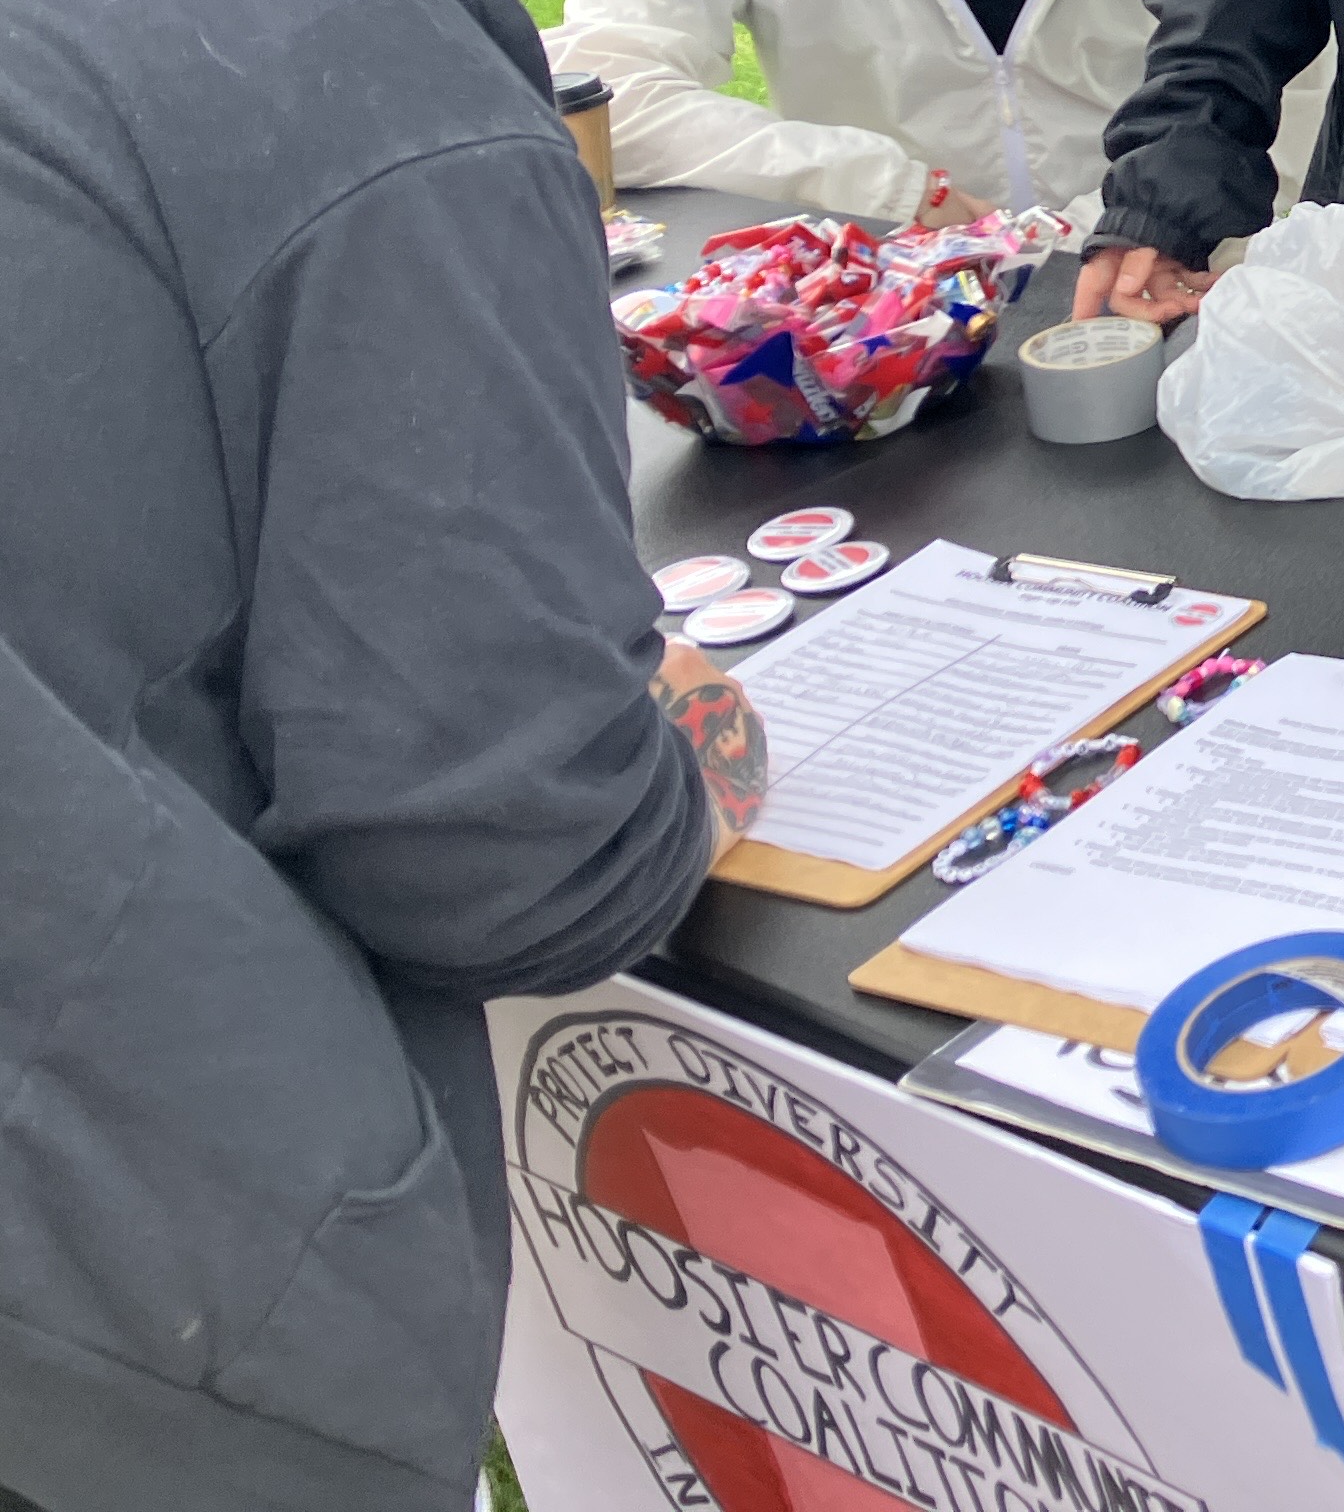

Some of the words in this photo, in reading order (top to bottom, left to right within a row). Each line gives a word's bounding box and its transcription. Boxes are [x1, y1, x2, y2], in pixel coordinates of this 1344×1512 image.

[530, 1026, 648, 1148] PROTECT
[667, 1034, 1043, 1323] DIVERSITY
[521, 1172, 866, 1401] HOOSIER
[868, 1344, 1209, 1512] COMMUN
[709, 1340, 1048, 1512] COALITI
[644, 1432, 712, 1510] IN
